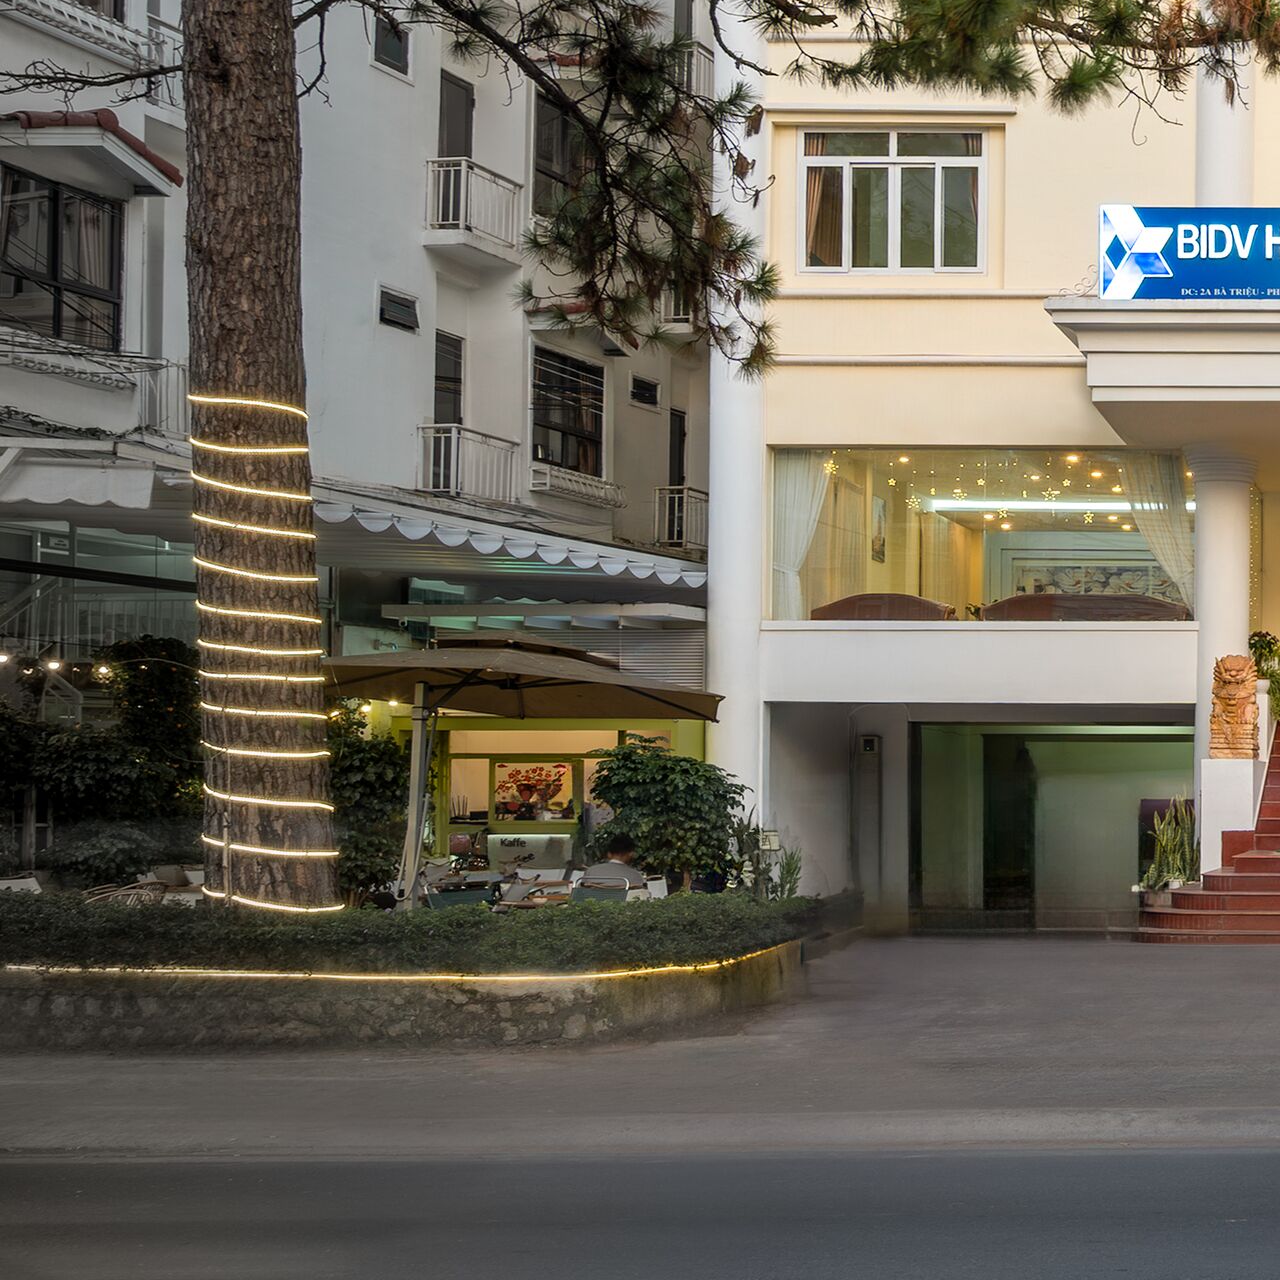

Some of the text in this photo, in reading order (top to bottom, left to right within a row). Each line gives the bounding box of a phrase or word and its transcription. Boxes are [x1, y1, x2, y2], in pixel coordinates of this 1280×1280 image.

[1177, 223, 1259, 259] BIDV
[1200, 288, 1212, 296] 2A
[1229, 286, 1260, 297] TRIỆU
